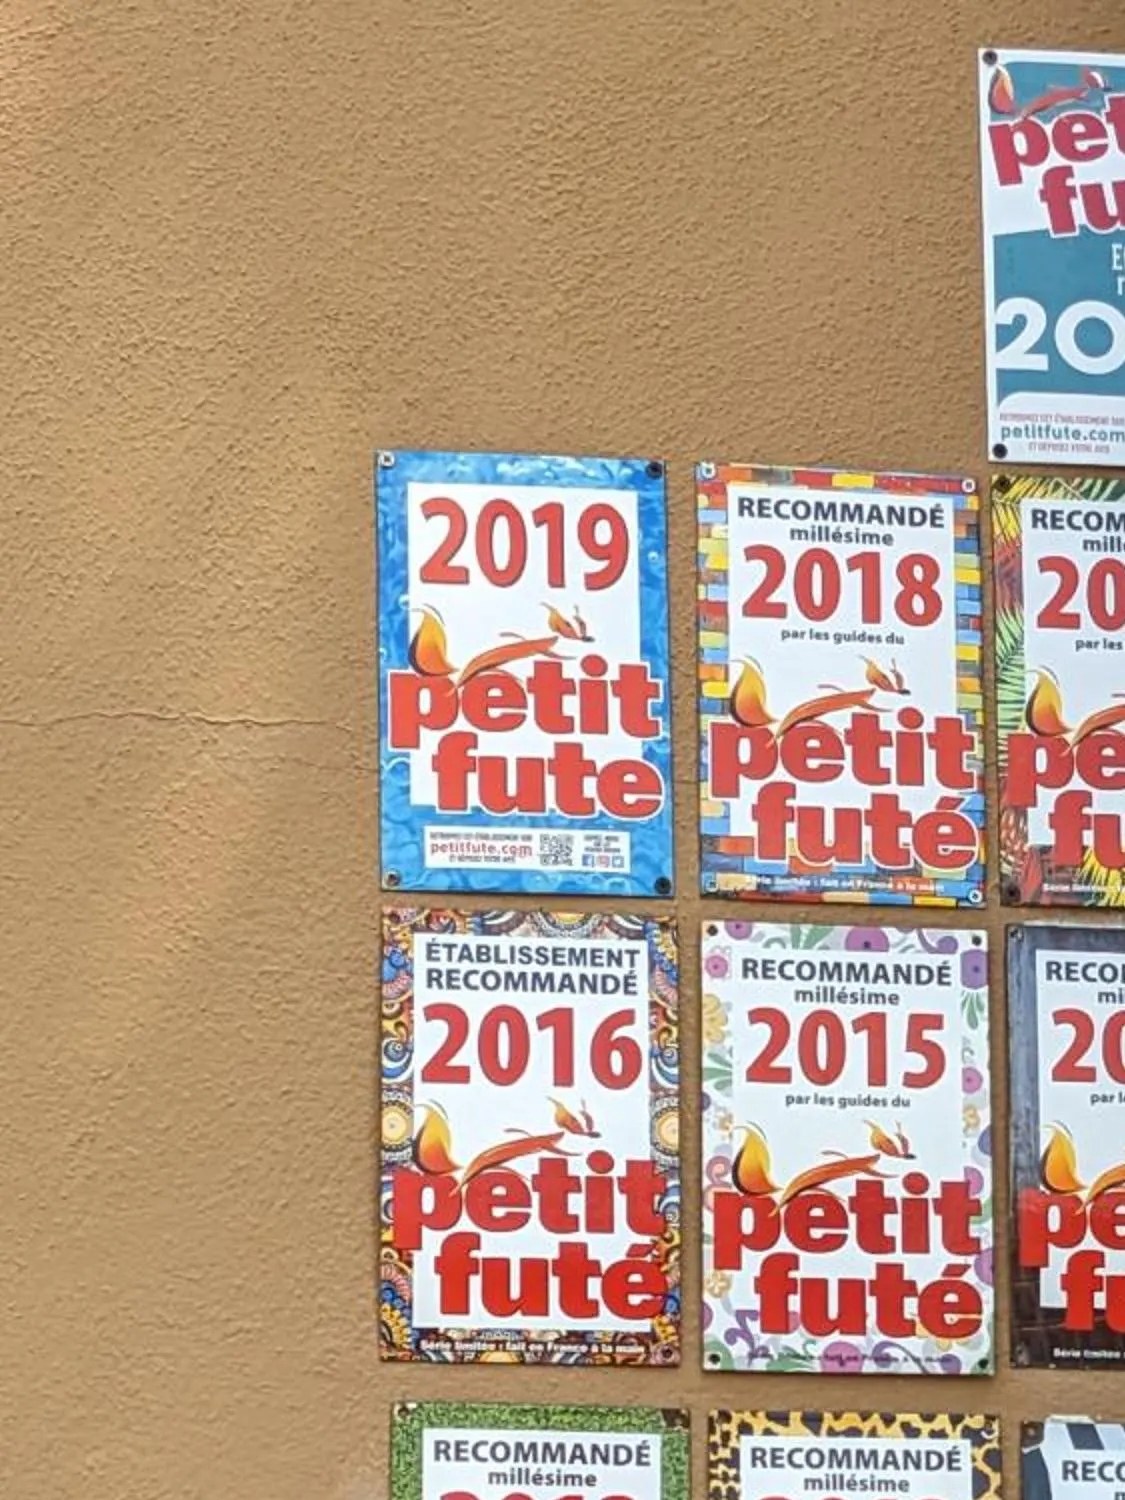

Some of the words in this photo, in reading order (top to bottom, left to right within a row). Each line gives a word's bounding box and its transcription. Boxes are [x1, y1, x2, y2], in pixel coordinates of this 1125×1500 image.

[1001, 424, 1125, 442] petitfute.com
[738, 498, 944, 528] RECOMMANDÉ
[420, 498, 629, 591] 2019
[790, 526, 893, 546] millésime
[742, 544, 941, 626] 2018
[390, 654, 661, 748] petit
[711, 708, 975, 798] petit
[753, 782, 977, 869] futé
[430, 841, 533, 856] petitfute.com
[425, 937, 640, 968] ÉTABLISSEMENT
[426, 969, 637, 995] RECOMMANDÉ
[742, 959, 951, 986] RECOMMANDÉ
[794, 986, 899, 1005] millésime
[421, 1003, 642, 1089] 2016
[745, 1007, 946, 1089] 2015
[785, 1095, 810, 1107] par
[814, 1093, 834, 1105] les
[838, 1095, 887, 1109] guides
[892, 1096, 910, 1107] du
[1091, 1093, 1114, 1106] par
[393, 1150, 666, 1249] petit
[713, 1172, 981, 1269] petit
[434, 1233, 667, 1319] futé
[754, 1253, 982, 1339] futé
[434, 1439, 650, 1466] RECOMMANDÉ
[751, 1446, 961, 1472] RECOMMANDÉ
[488, 1468, 597, 1487] millésime
[804, 1475, 909, 1493] millésime
